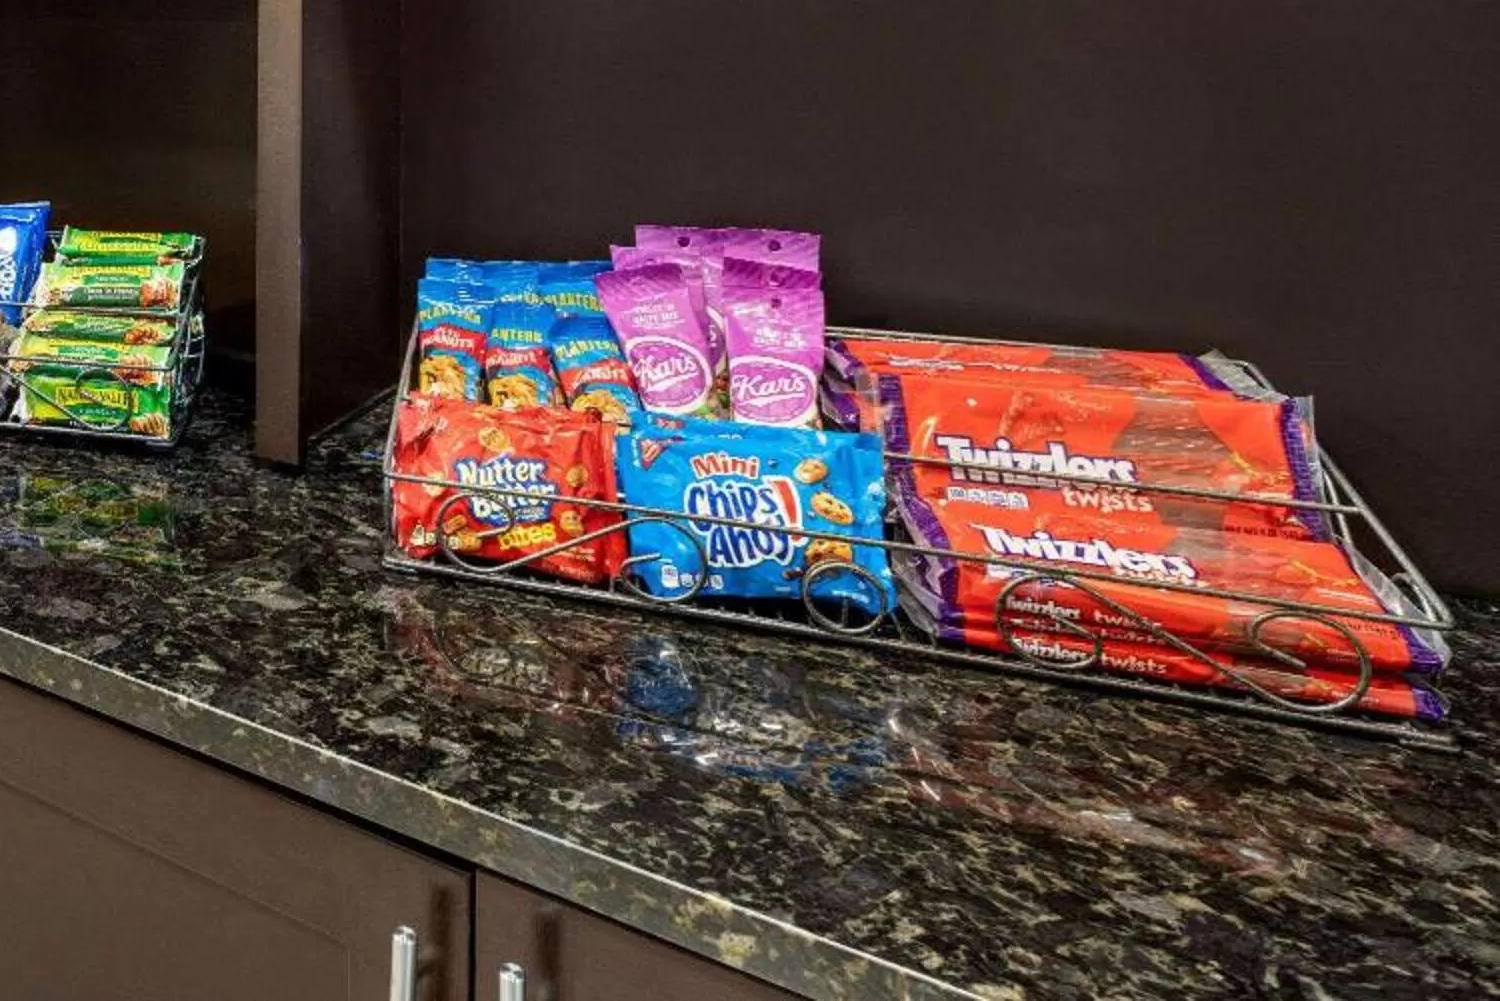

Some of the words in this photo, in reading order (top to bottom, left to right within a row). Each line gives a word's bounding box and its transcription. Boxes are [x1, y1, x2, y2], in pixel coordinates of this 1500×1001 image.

[457, 455, 546, 486] Nutter
[690, 453, 761, 480] Mini
[934, 433, 1141, 491] Twizzlers
[686, 480, 780, 533] Chips
[1061, 486, 1153, 514] twists
[969, 522, 1198, 579] Twizzlers
